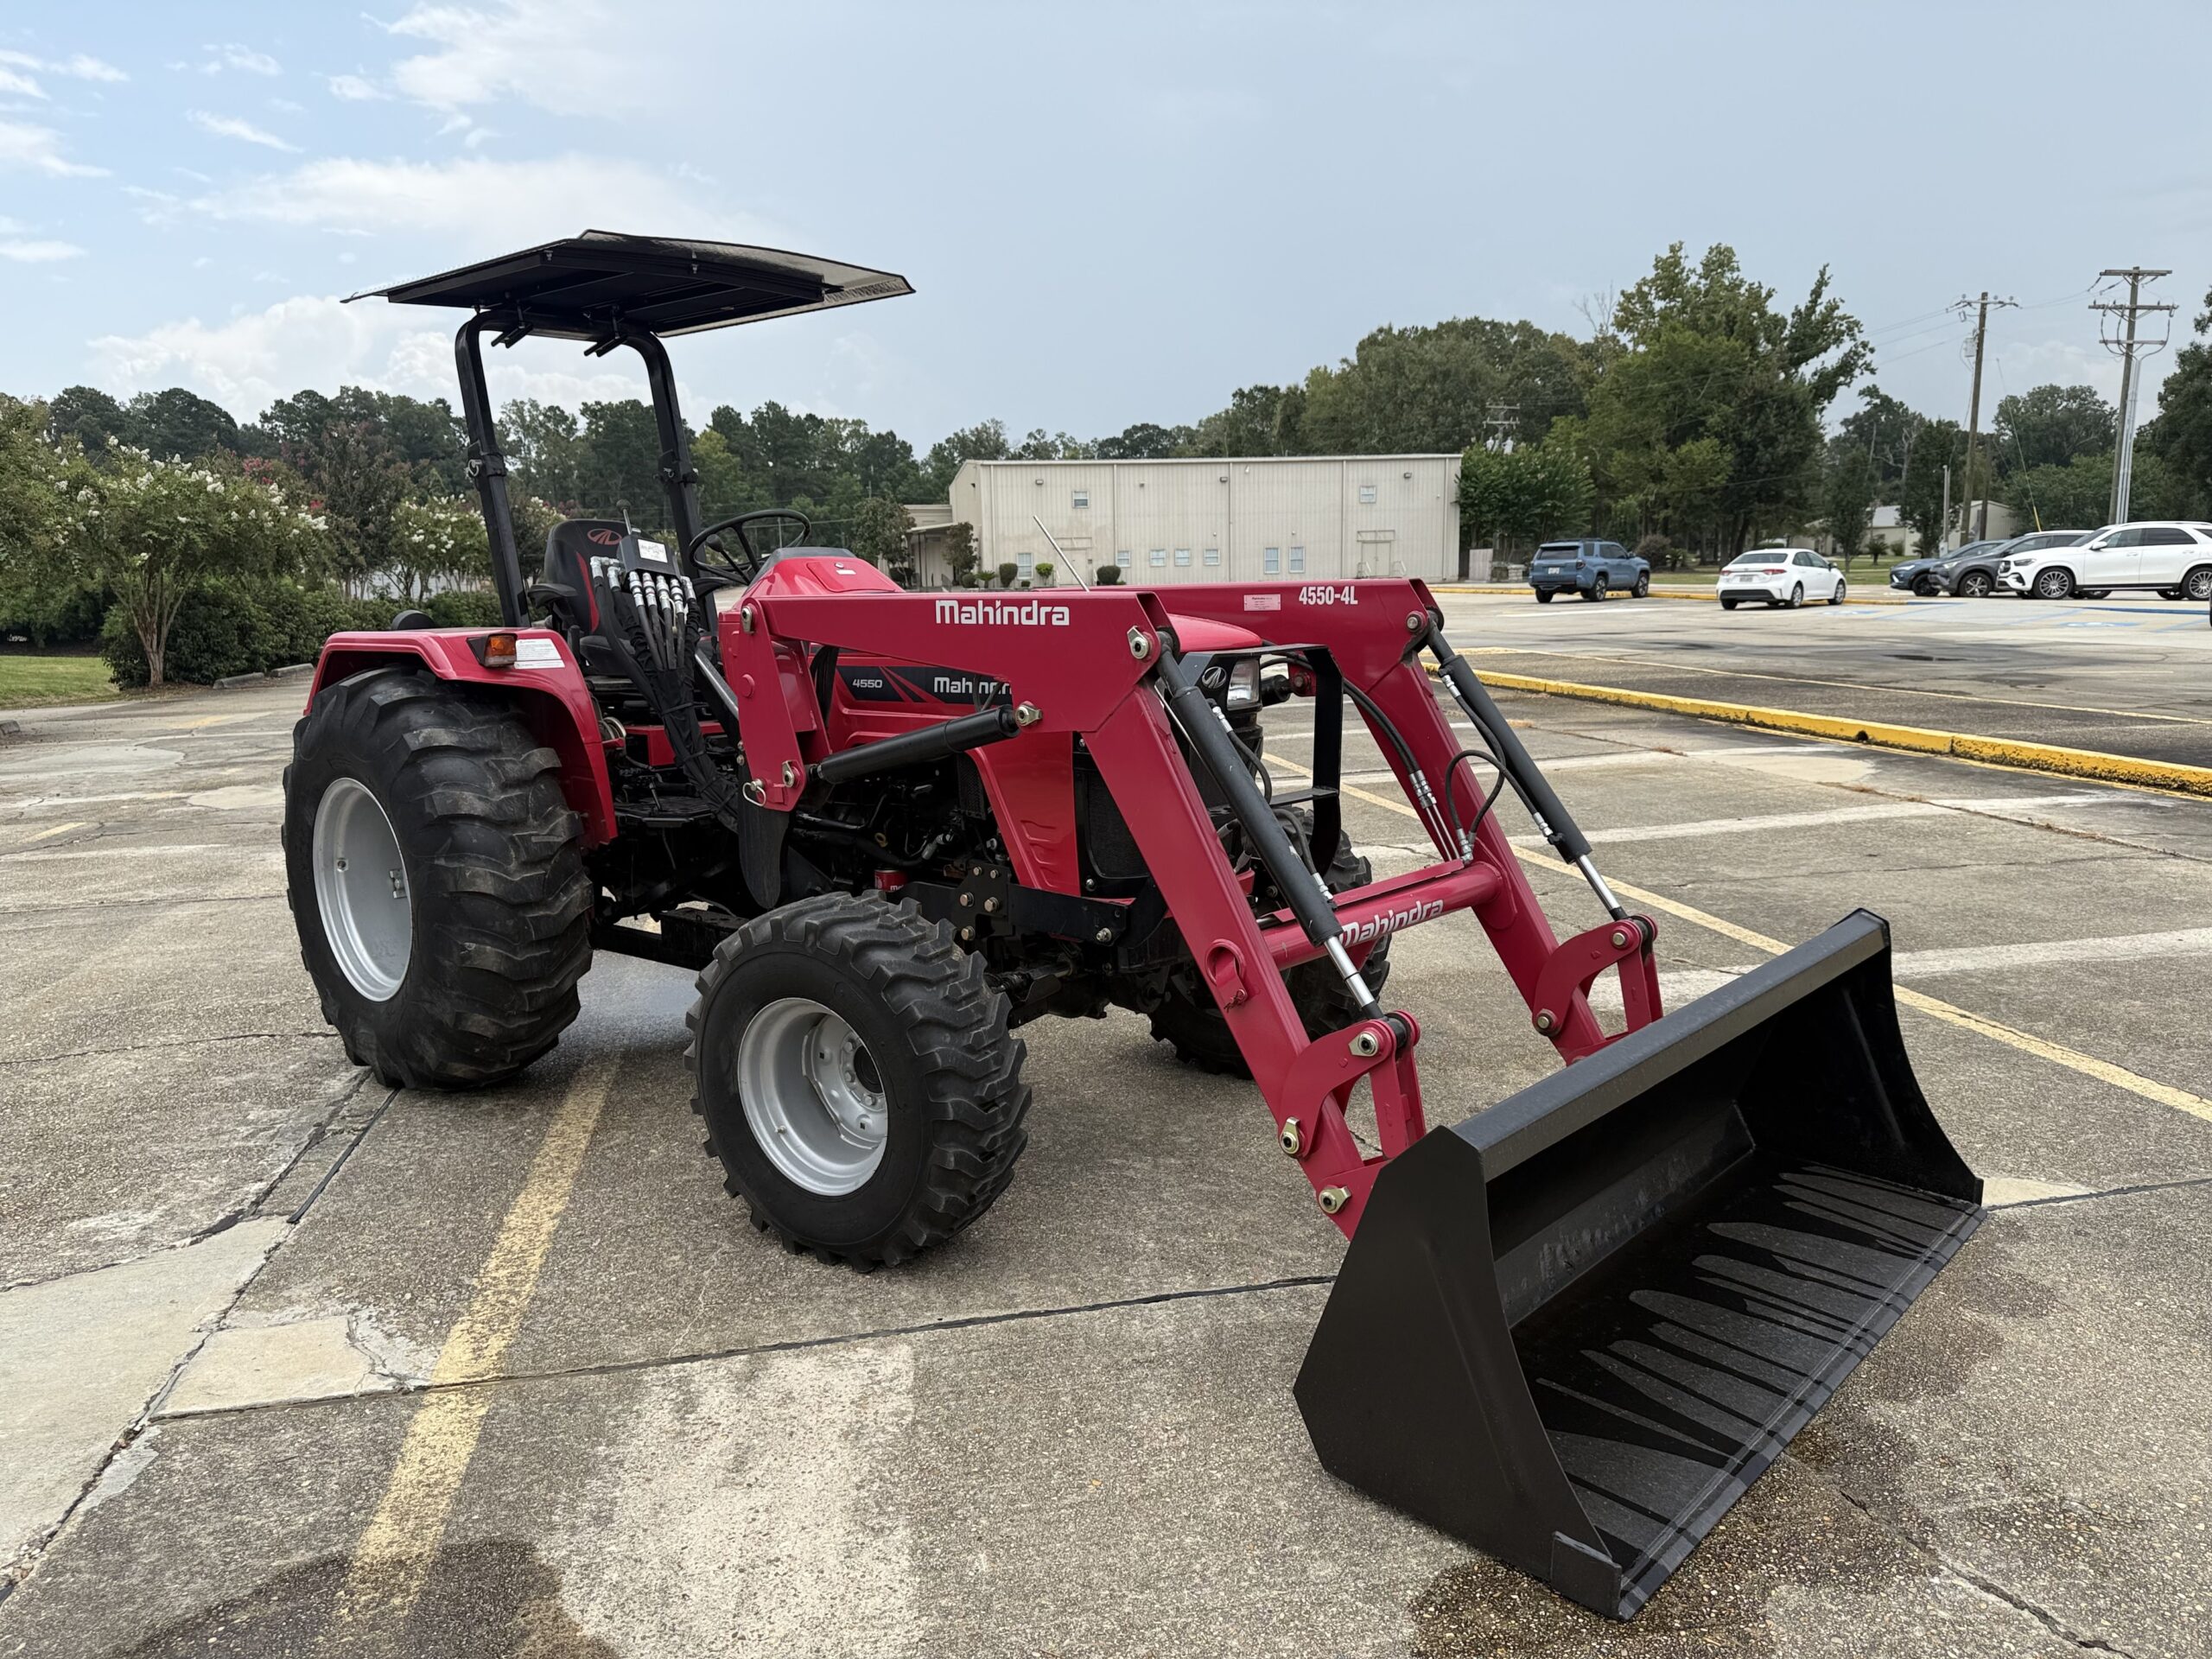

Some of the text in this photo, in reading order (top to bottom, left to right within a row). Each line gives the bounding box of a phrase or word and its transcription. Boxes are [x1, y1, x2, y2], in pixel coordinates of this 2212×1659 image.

[1299, 586, 1358, 605] 4550-4L
[936, 600, 1070, 626] Mahindra
[852, 679, 883, 689] 4550
[1339, 899, 1444, 946] Mahindra
